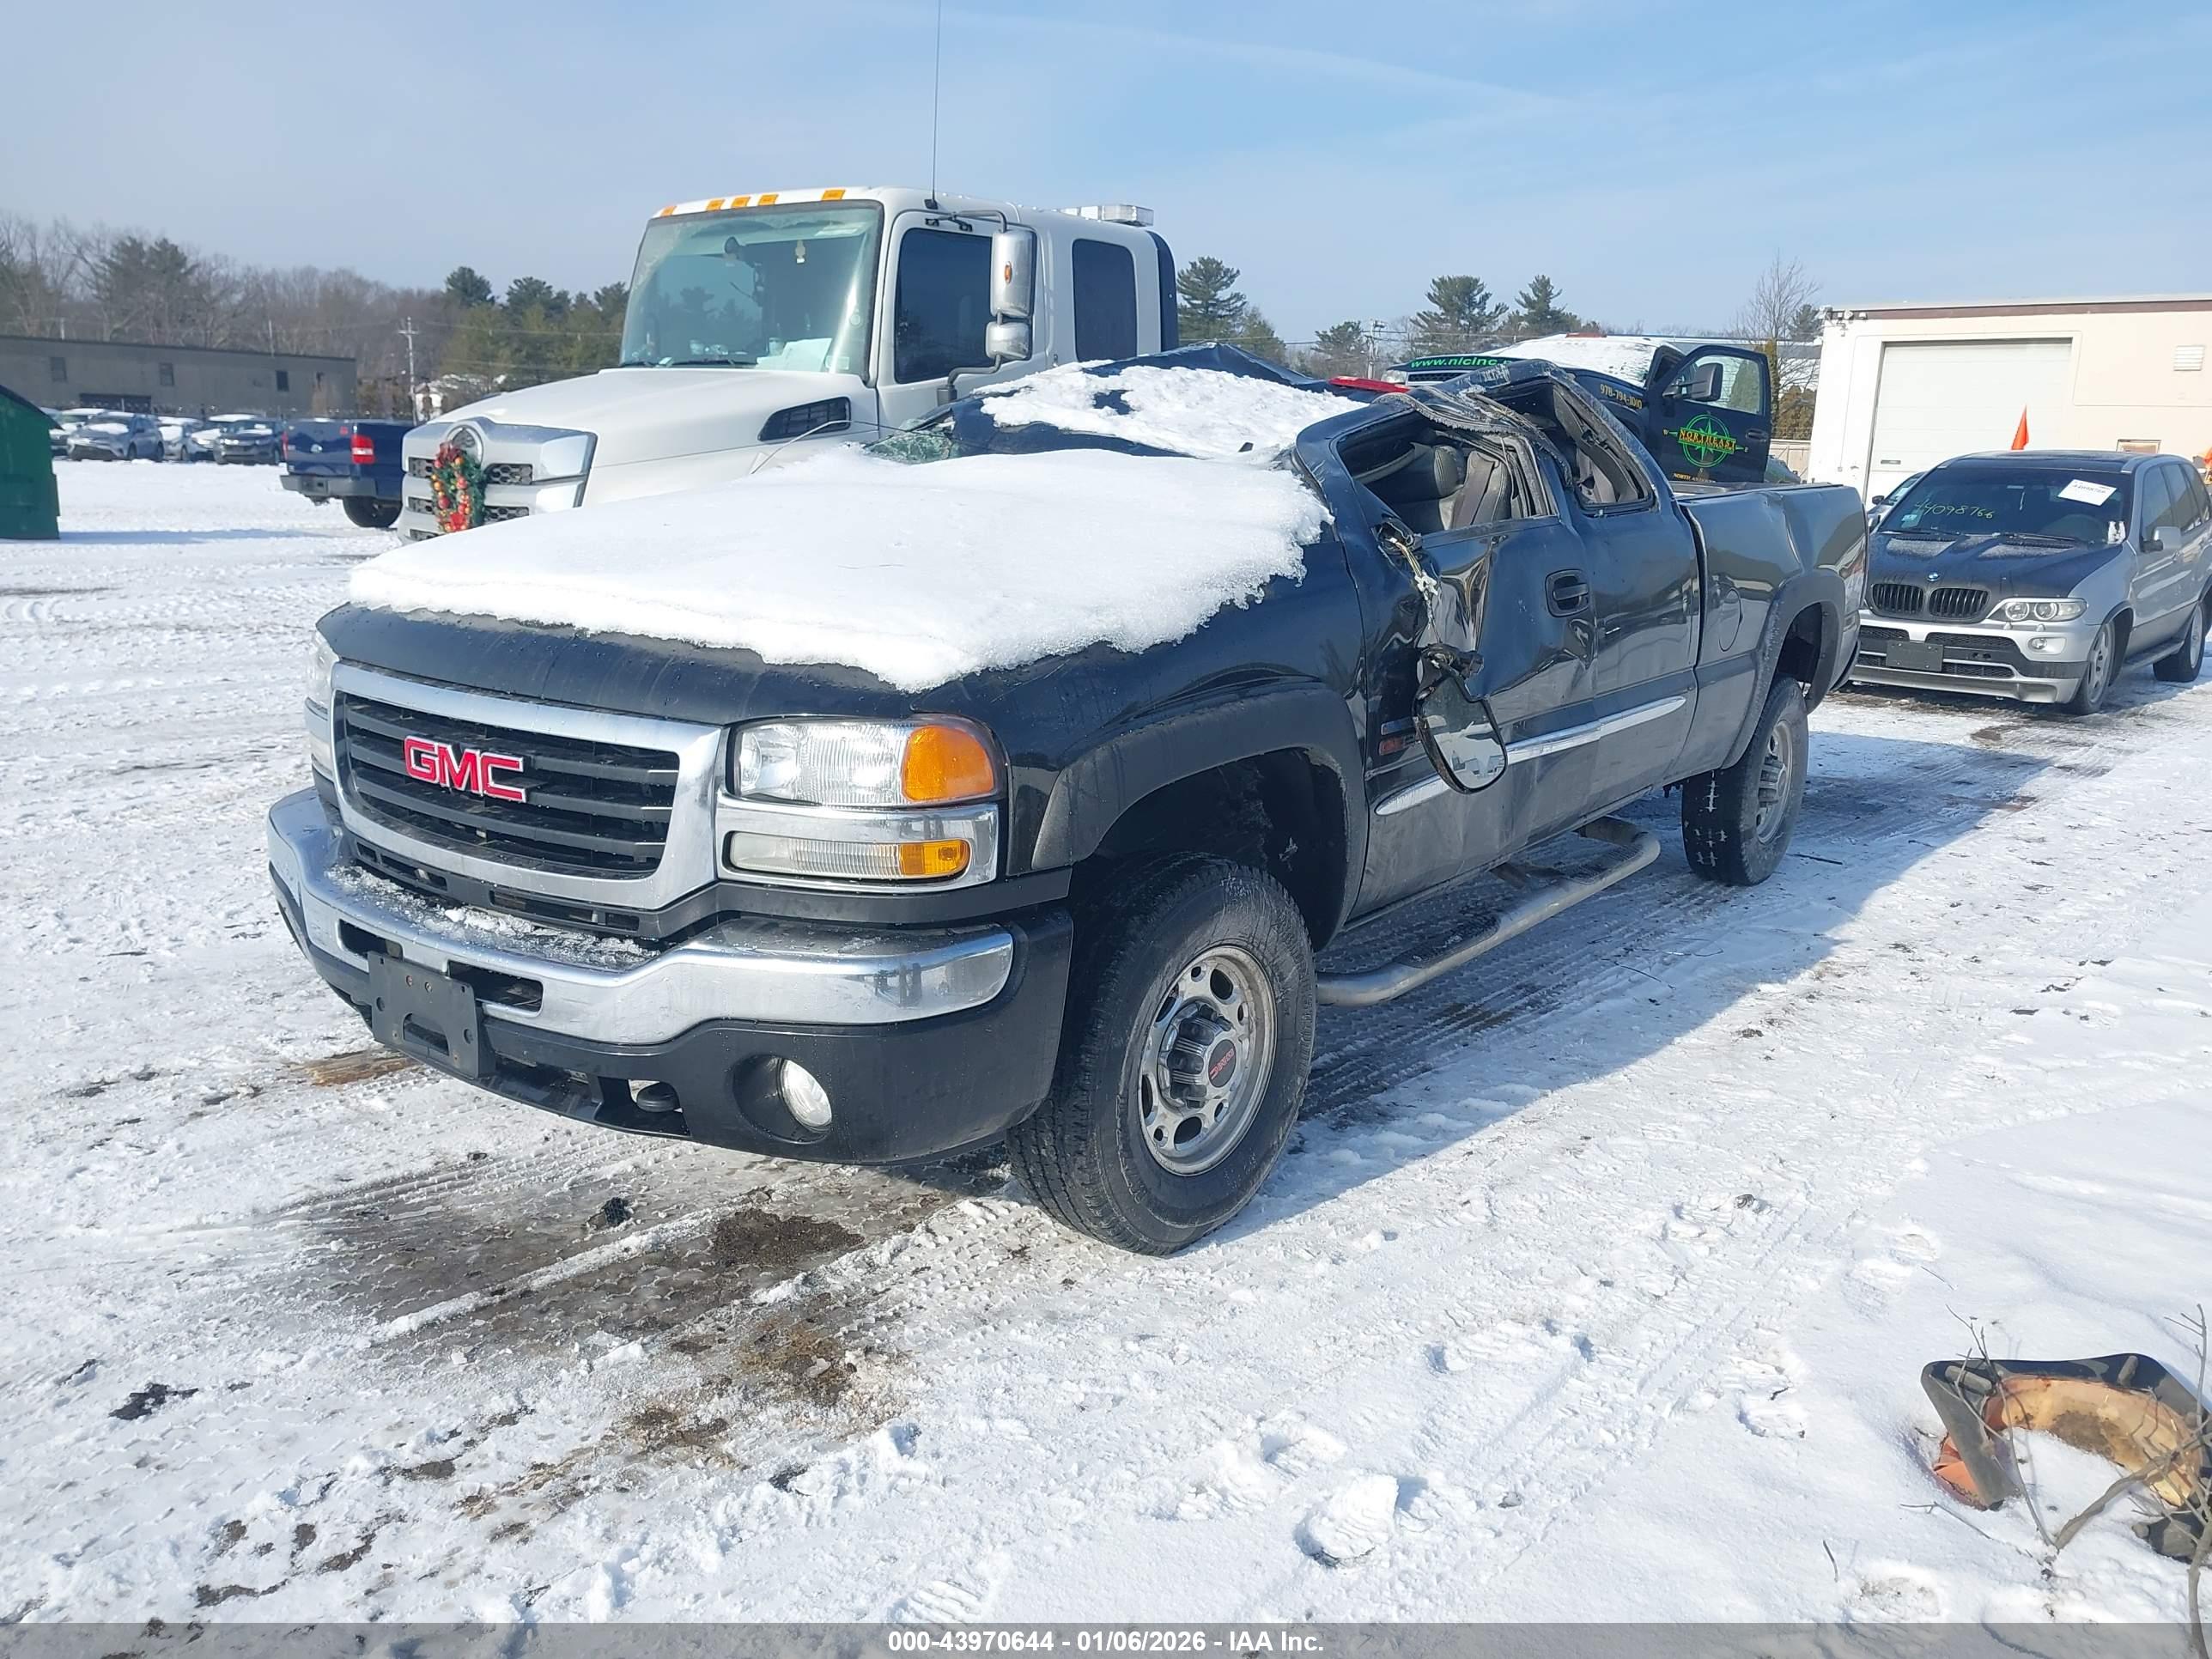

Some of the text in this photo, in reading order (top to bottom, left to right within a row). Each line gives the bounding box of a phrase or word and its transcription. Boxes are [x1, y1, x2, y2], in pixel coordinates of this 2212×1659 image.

[1600, 383, 1643, 410] 978-794-1010
[1679, 429, 1736, 448] NORTHEAST
[1915, 498, 1996, 519] 44098766
[404, 735, 526, 803] GMC
[1209, 1048, 1235, 1080] GMC
